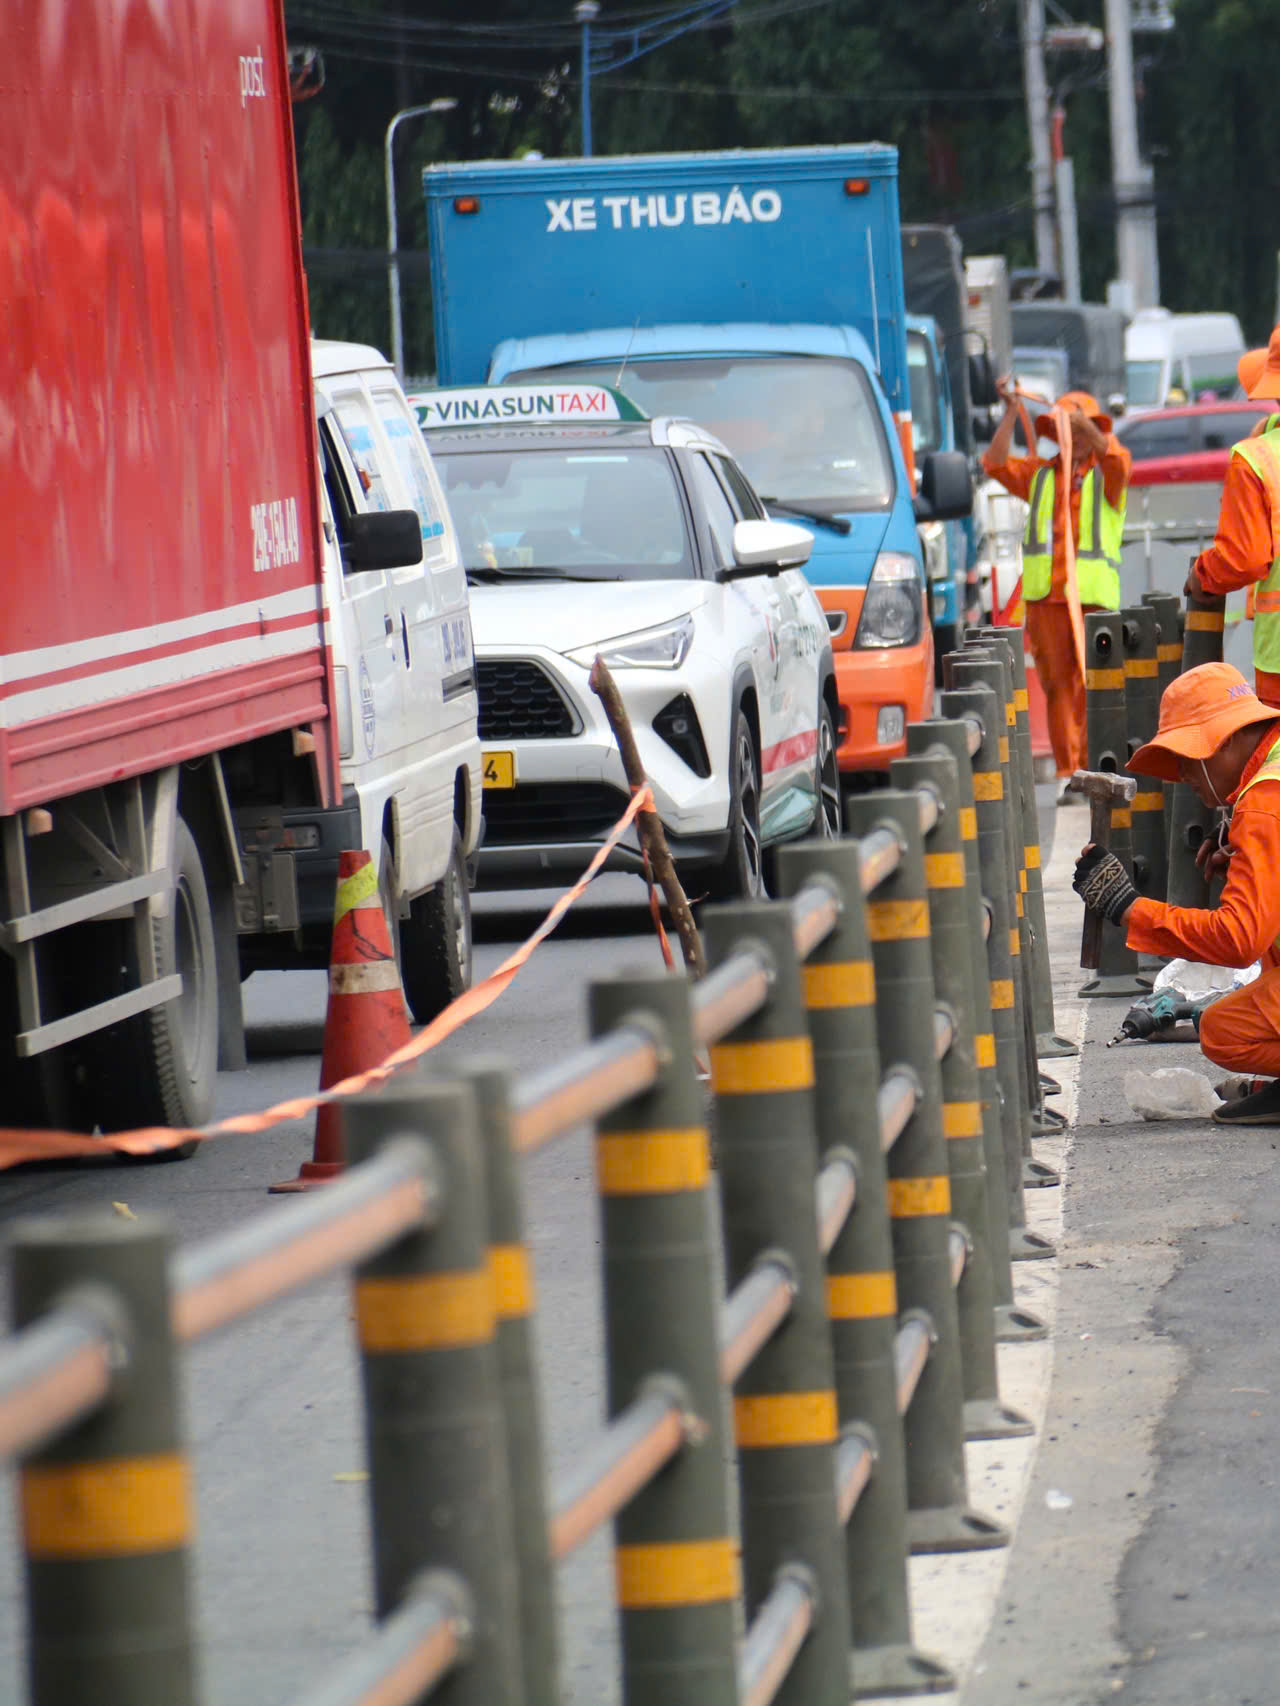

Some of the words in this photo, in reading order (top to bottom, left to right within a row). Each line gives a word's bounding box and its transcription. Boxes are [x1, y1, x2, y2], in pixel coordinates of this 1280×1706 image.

[239, 44, 266, 109] post
[545, 196, 597, 233] XE
[602, 192, 688, 230] THƯ
[691, 185, 783, 226] BÁO
